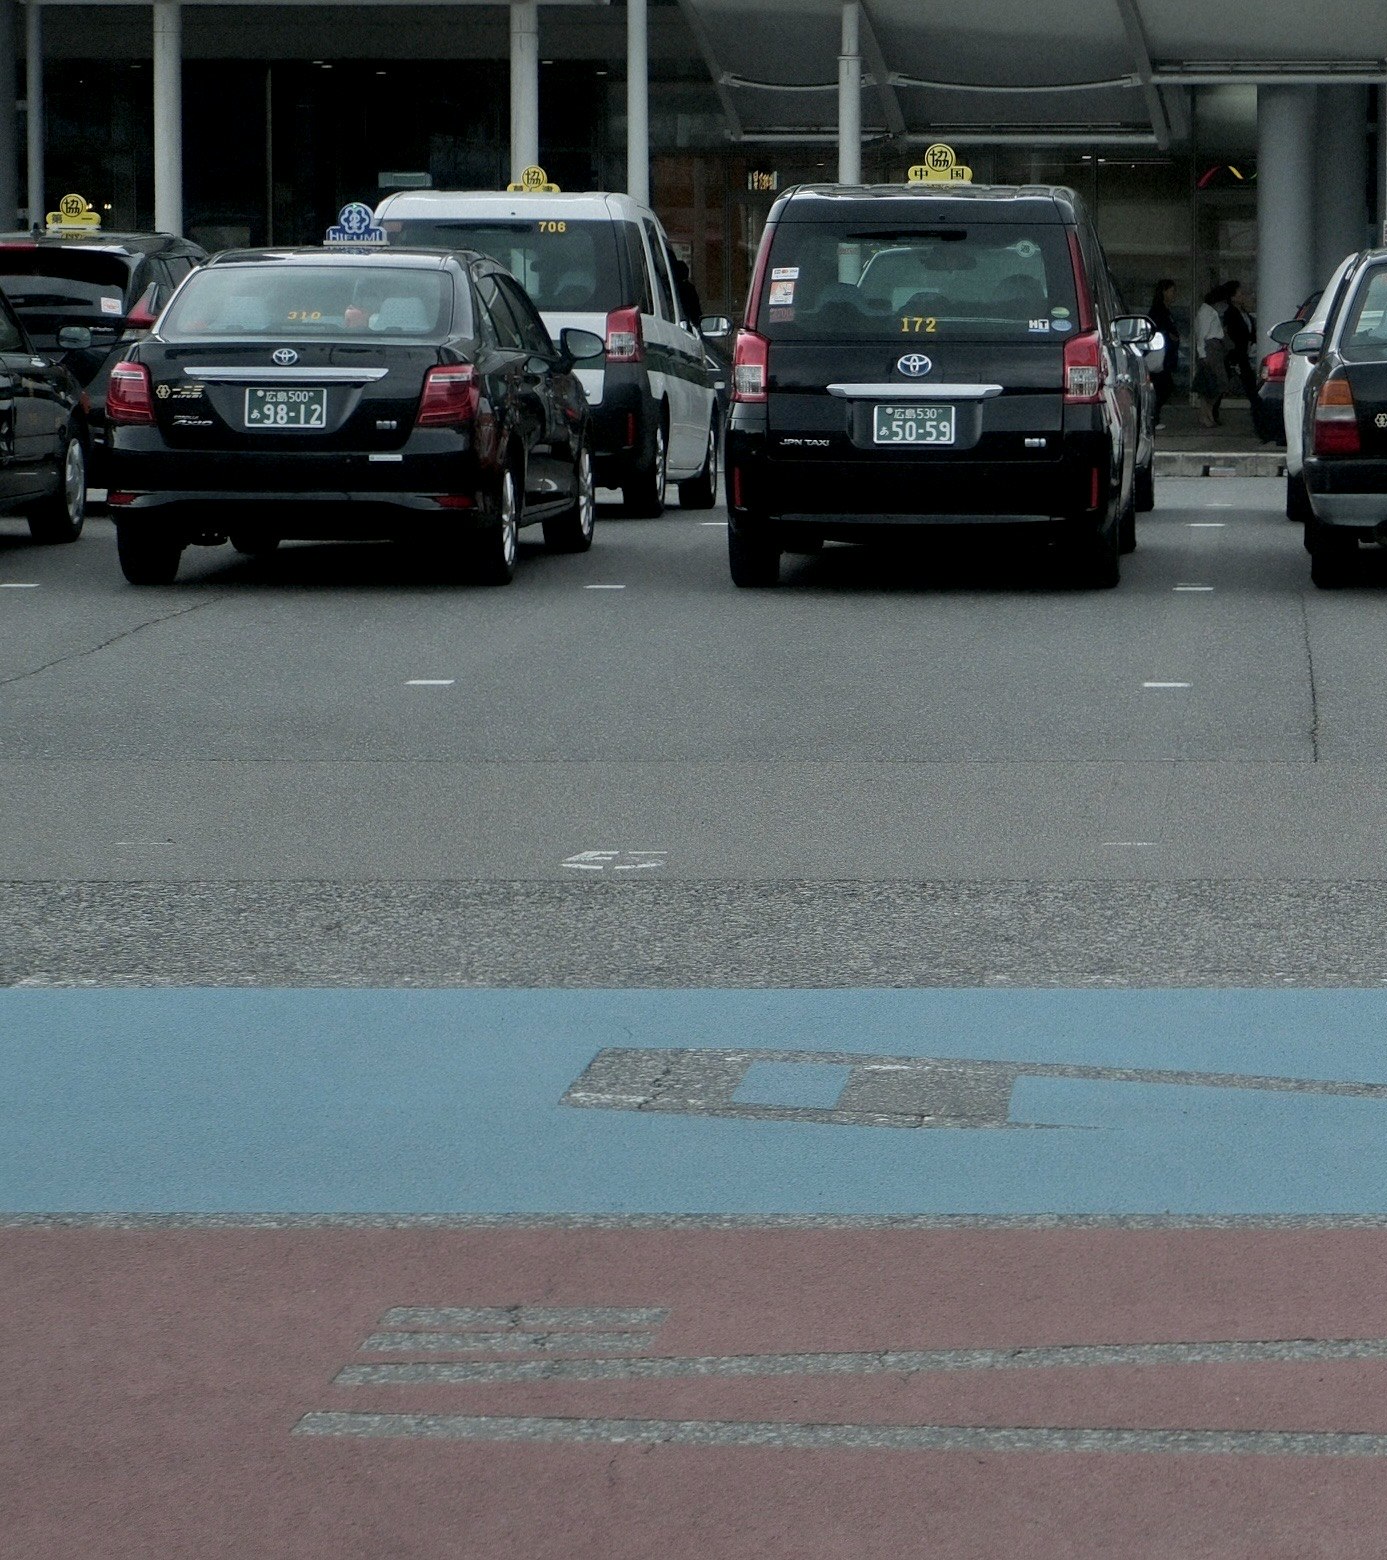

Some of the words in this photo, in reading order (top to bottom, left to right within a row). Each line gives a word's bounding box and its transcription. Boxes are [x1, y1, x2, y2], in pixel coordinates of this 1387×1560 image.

[928, 149, 949, 168] 協
[914, 167, 965, 180] 中国
[64, 199, 81, 214] 協
[52, 213, 93, 224] 第一
[539, 221, 566, 233] 706
[287, 311, 321, 320] 310
[902, 317, 936, 332] 172
[265, 390, 309, 402] 広島500
[263, 404, 322, 425] 98-12
[893, 408, 937, 419] 広島530
[891, 421, 950, 441] 50-59
